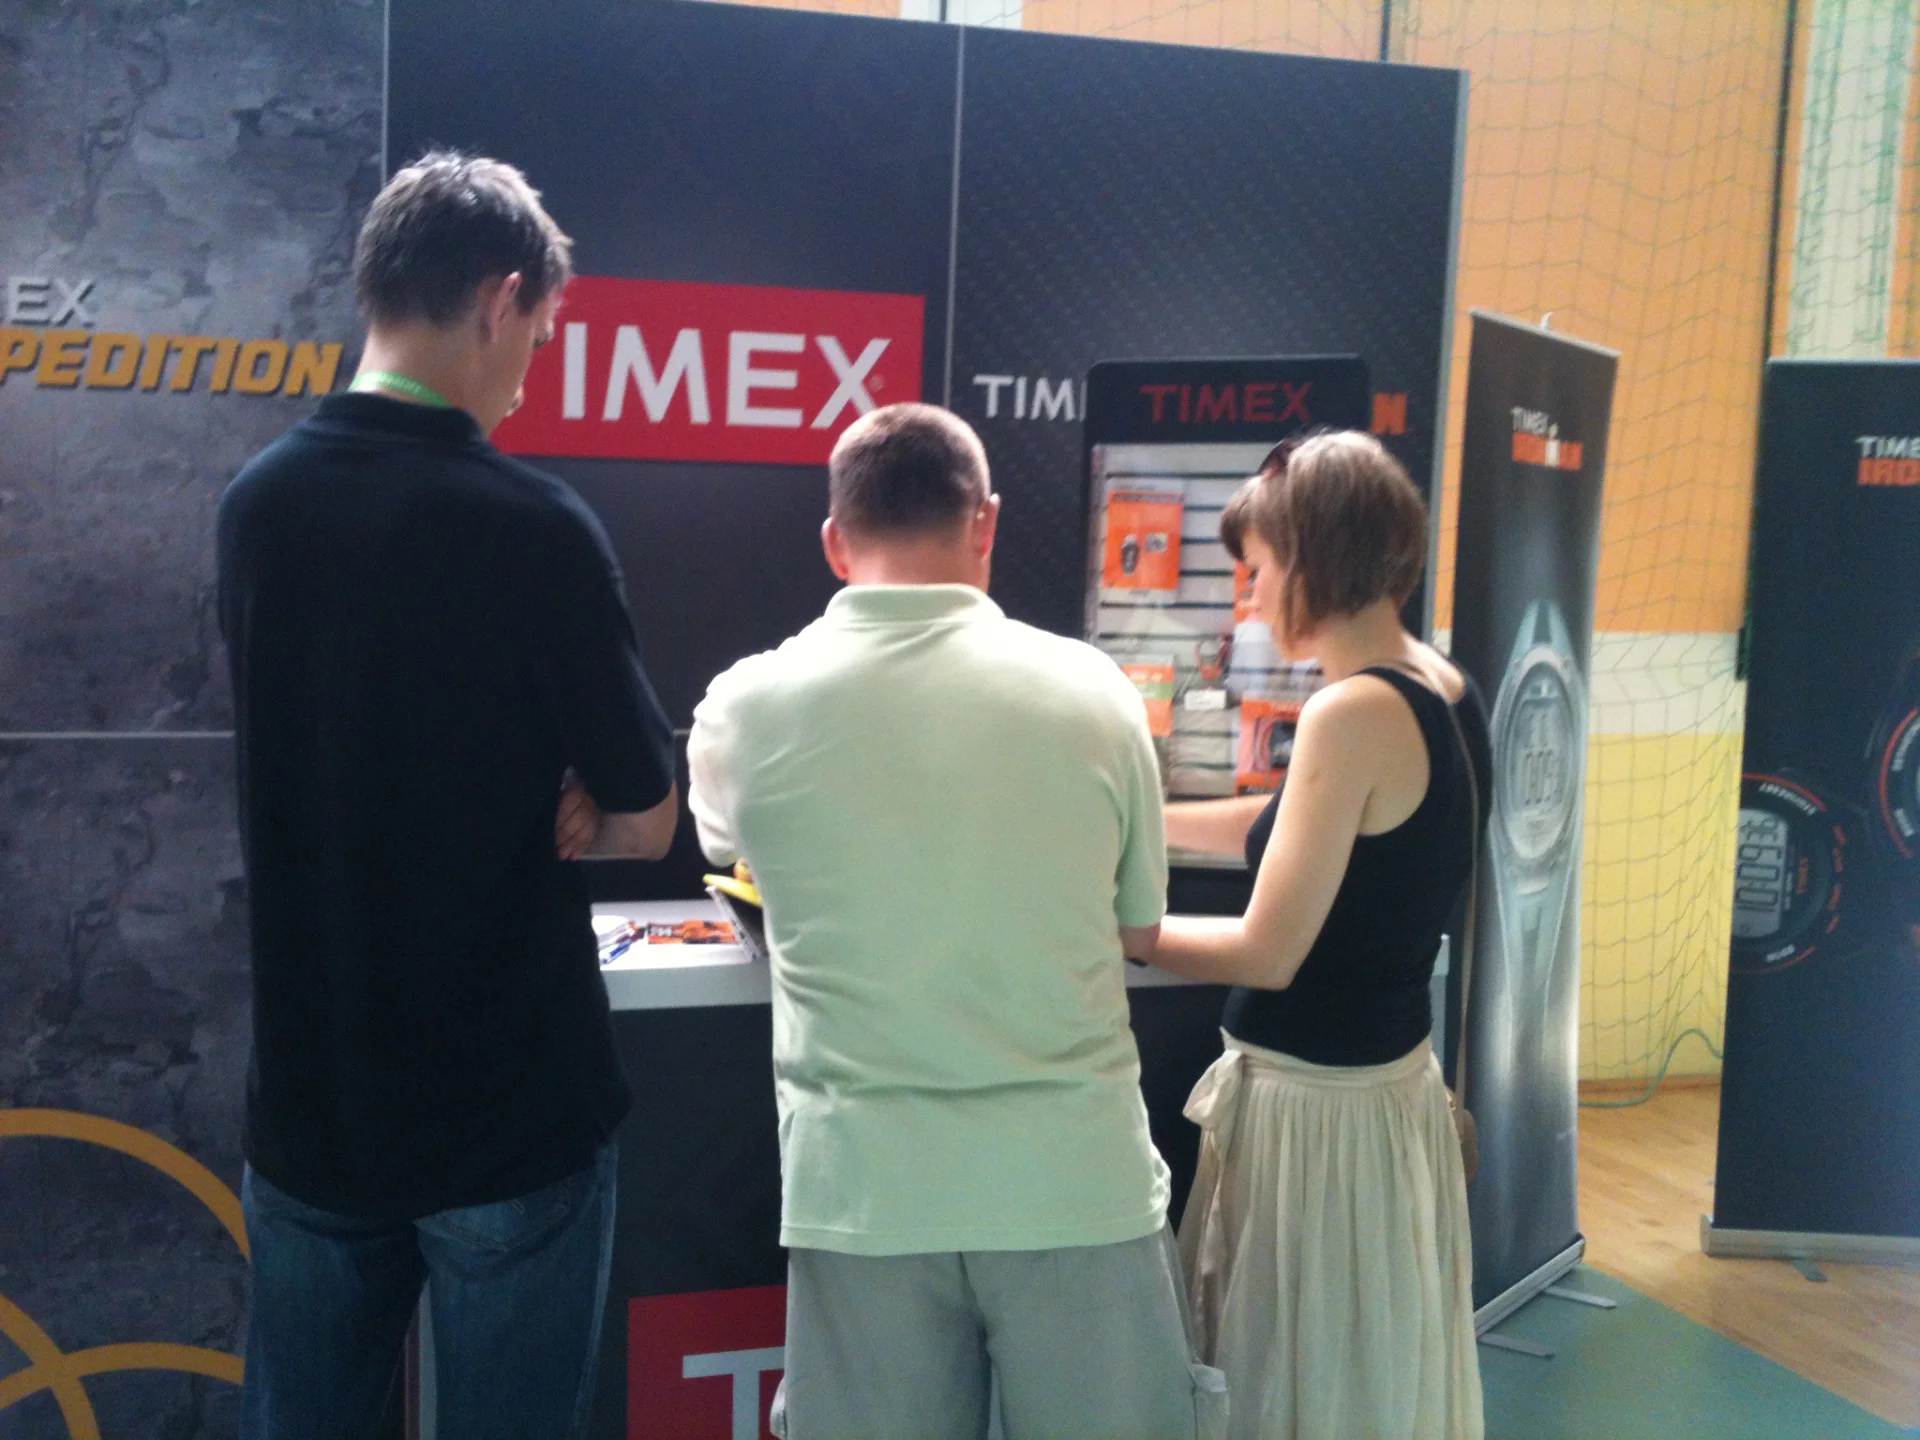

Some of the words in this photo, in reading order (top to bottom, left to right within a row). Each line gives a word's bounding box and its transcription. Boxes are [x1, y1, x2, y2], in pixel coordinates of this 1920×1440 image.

[0, 327, 344, 396] PEDITION
[973, 375, 1087, 423] TIM
[1138, 382, 1314, 425] TIMEX
